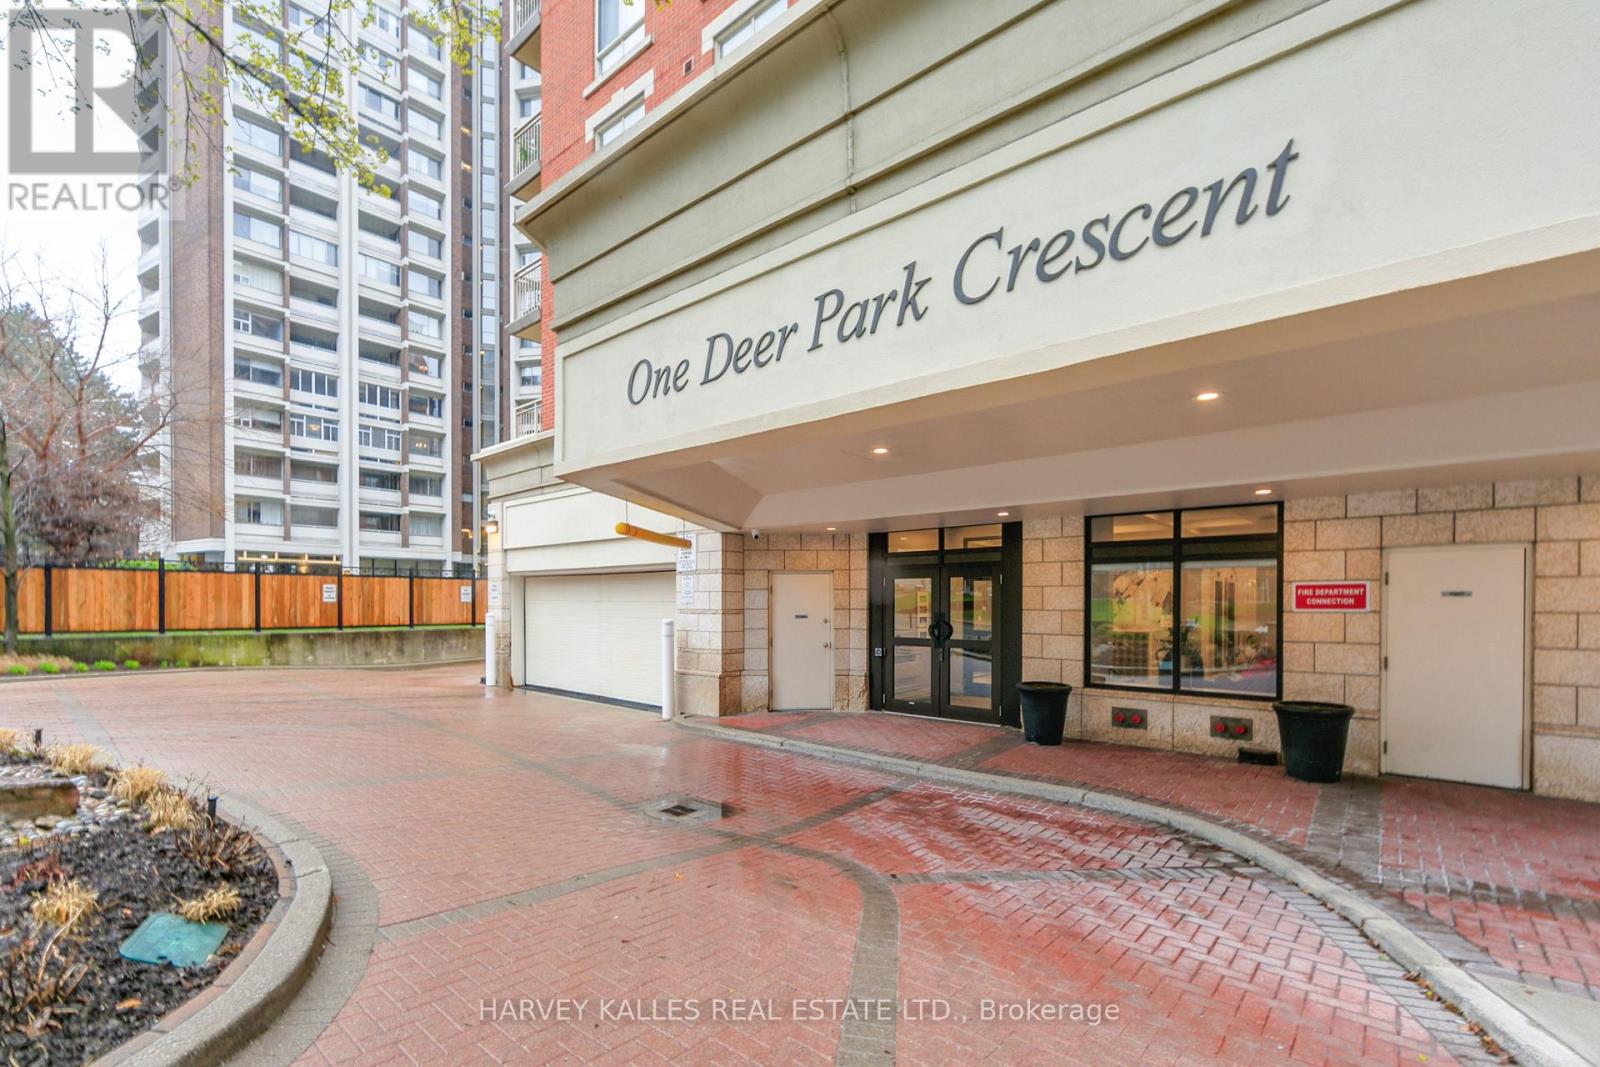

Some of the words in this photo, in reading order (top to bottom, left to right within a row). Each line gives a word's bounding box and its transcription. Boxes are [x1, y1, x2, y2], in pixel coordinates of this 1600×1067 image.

[627, 357, 690, 405] One
[699, 321, 799, 386] Deer
[807, 261, 932, 352] Park
[952, 138, 1299, 305] Crescent
[1297, 588, 1314, 596] FIRE
[1315, 588, 1364, 596] DEPARTMENT
[1306, 597, 1355, 605] CONNECTION
